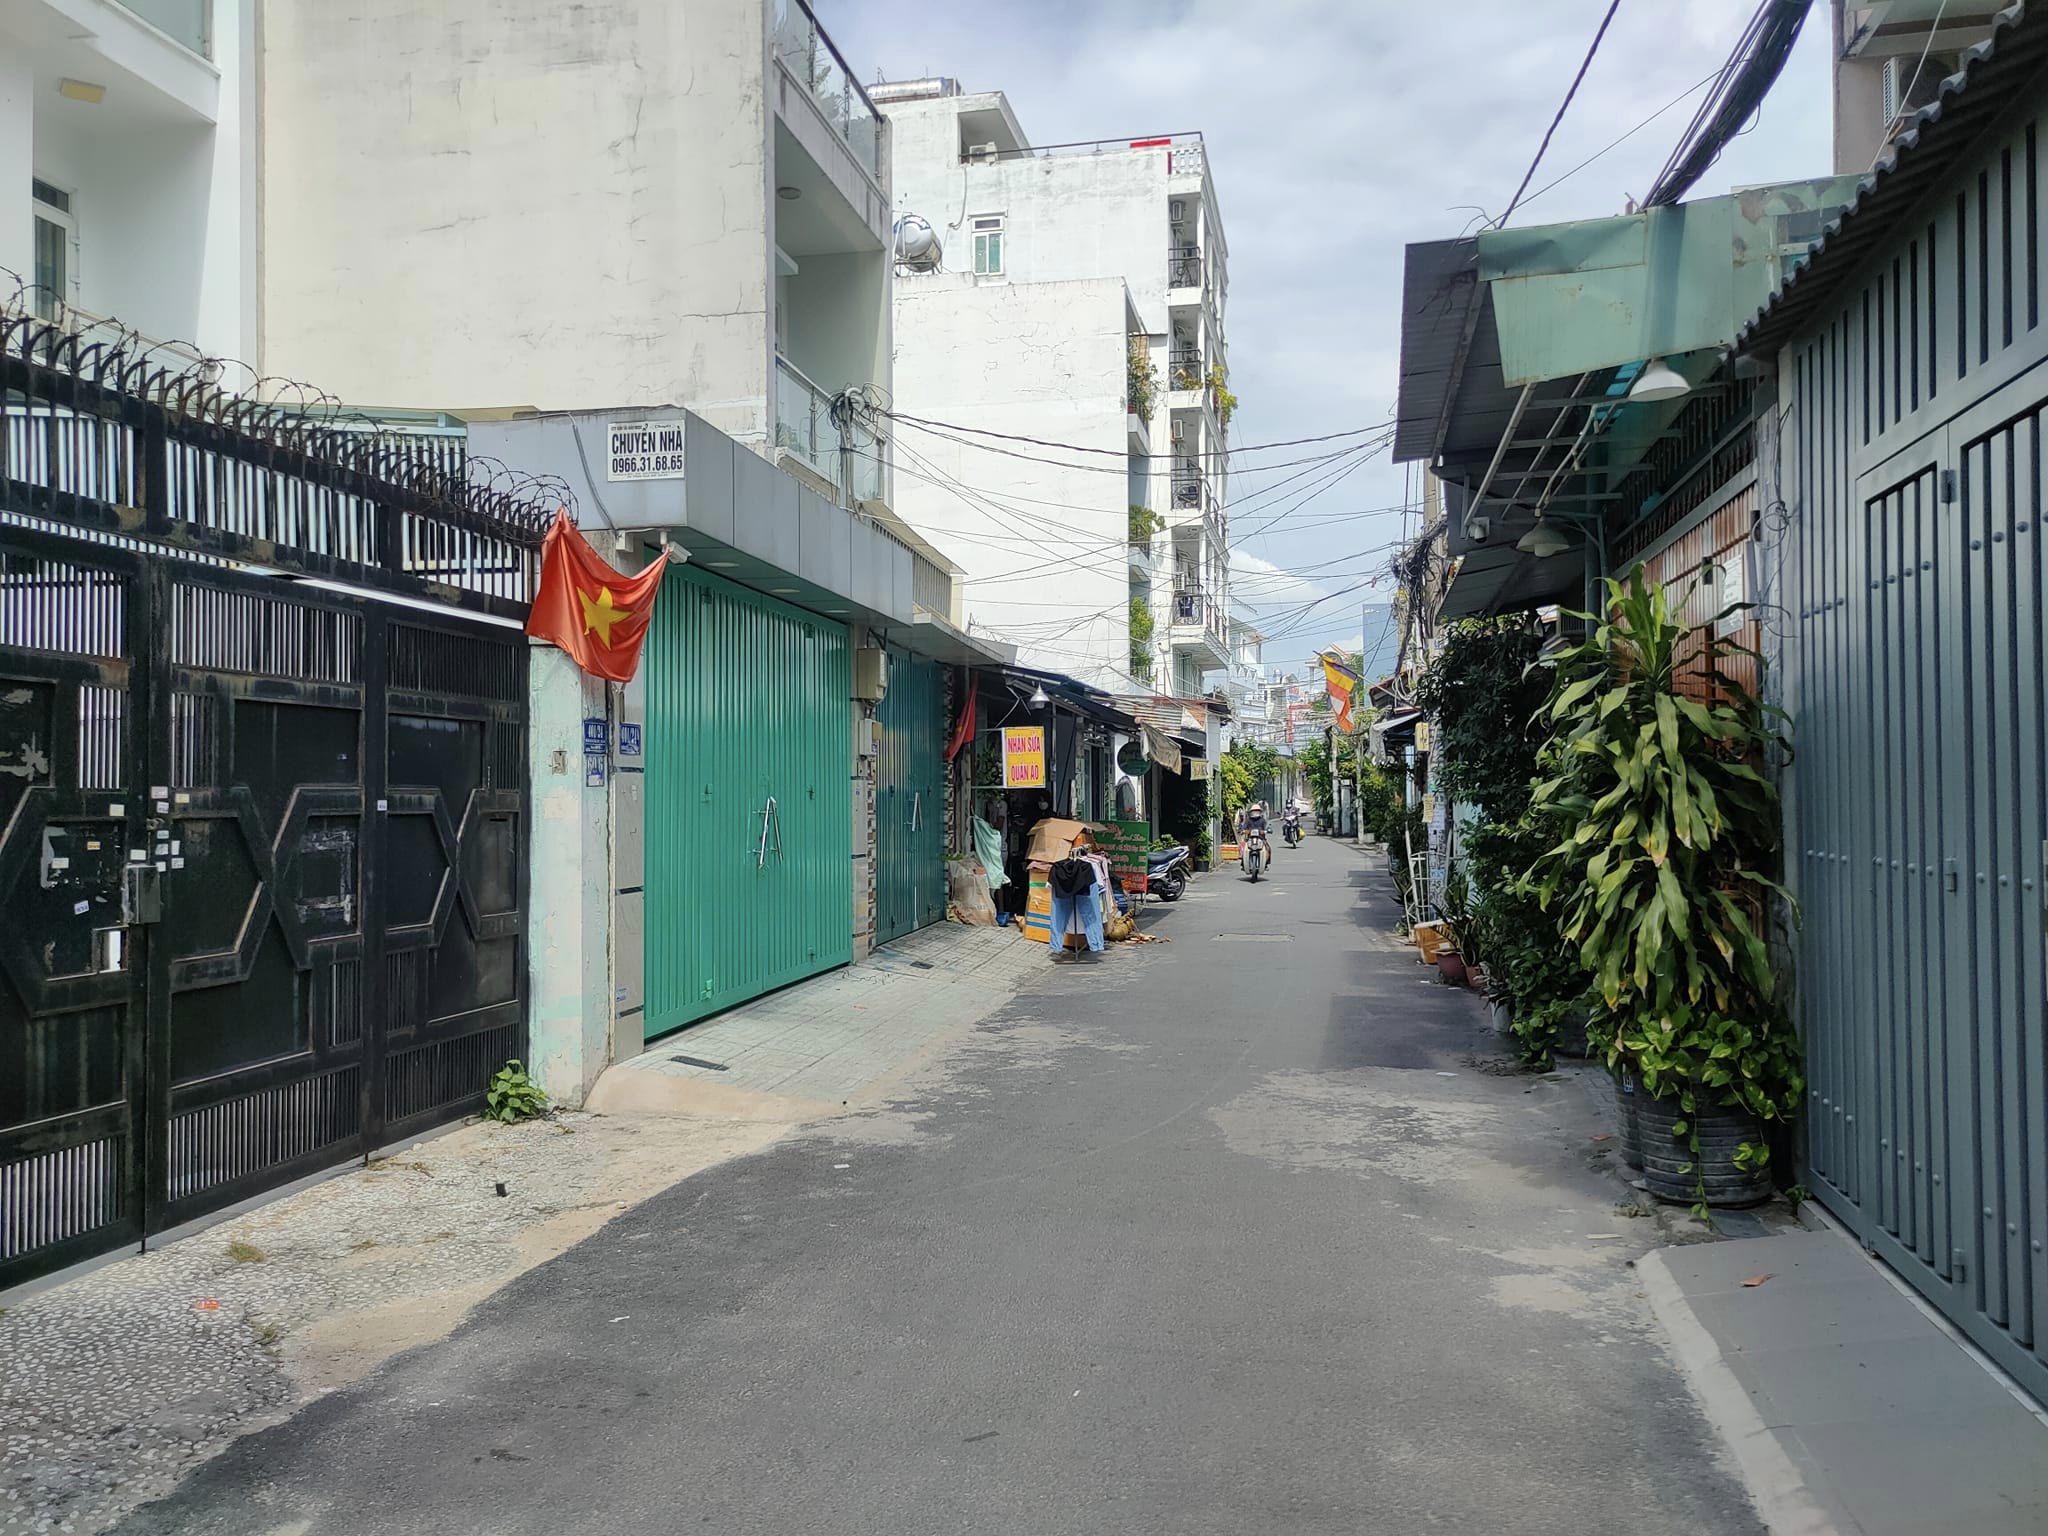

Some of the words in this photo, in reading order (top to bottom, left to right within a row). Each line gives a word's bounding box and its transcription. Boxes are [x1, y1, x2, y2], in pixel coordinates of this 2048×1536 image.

[612, 423, 655, 454] CHUYỂN
[660, 426, 683, 452] NHÀ
[612, 455, 683, 473] 0966.31.68.65
